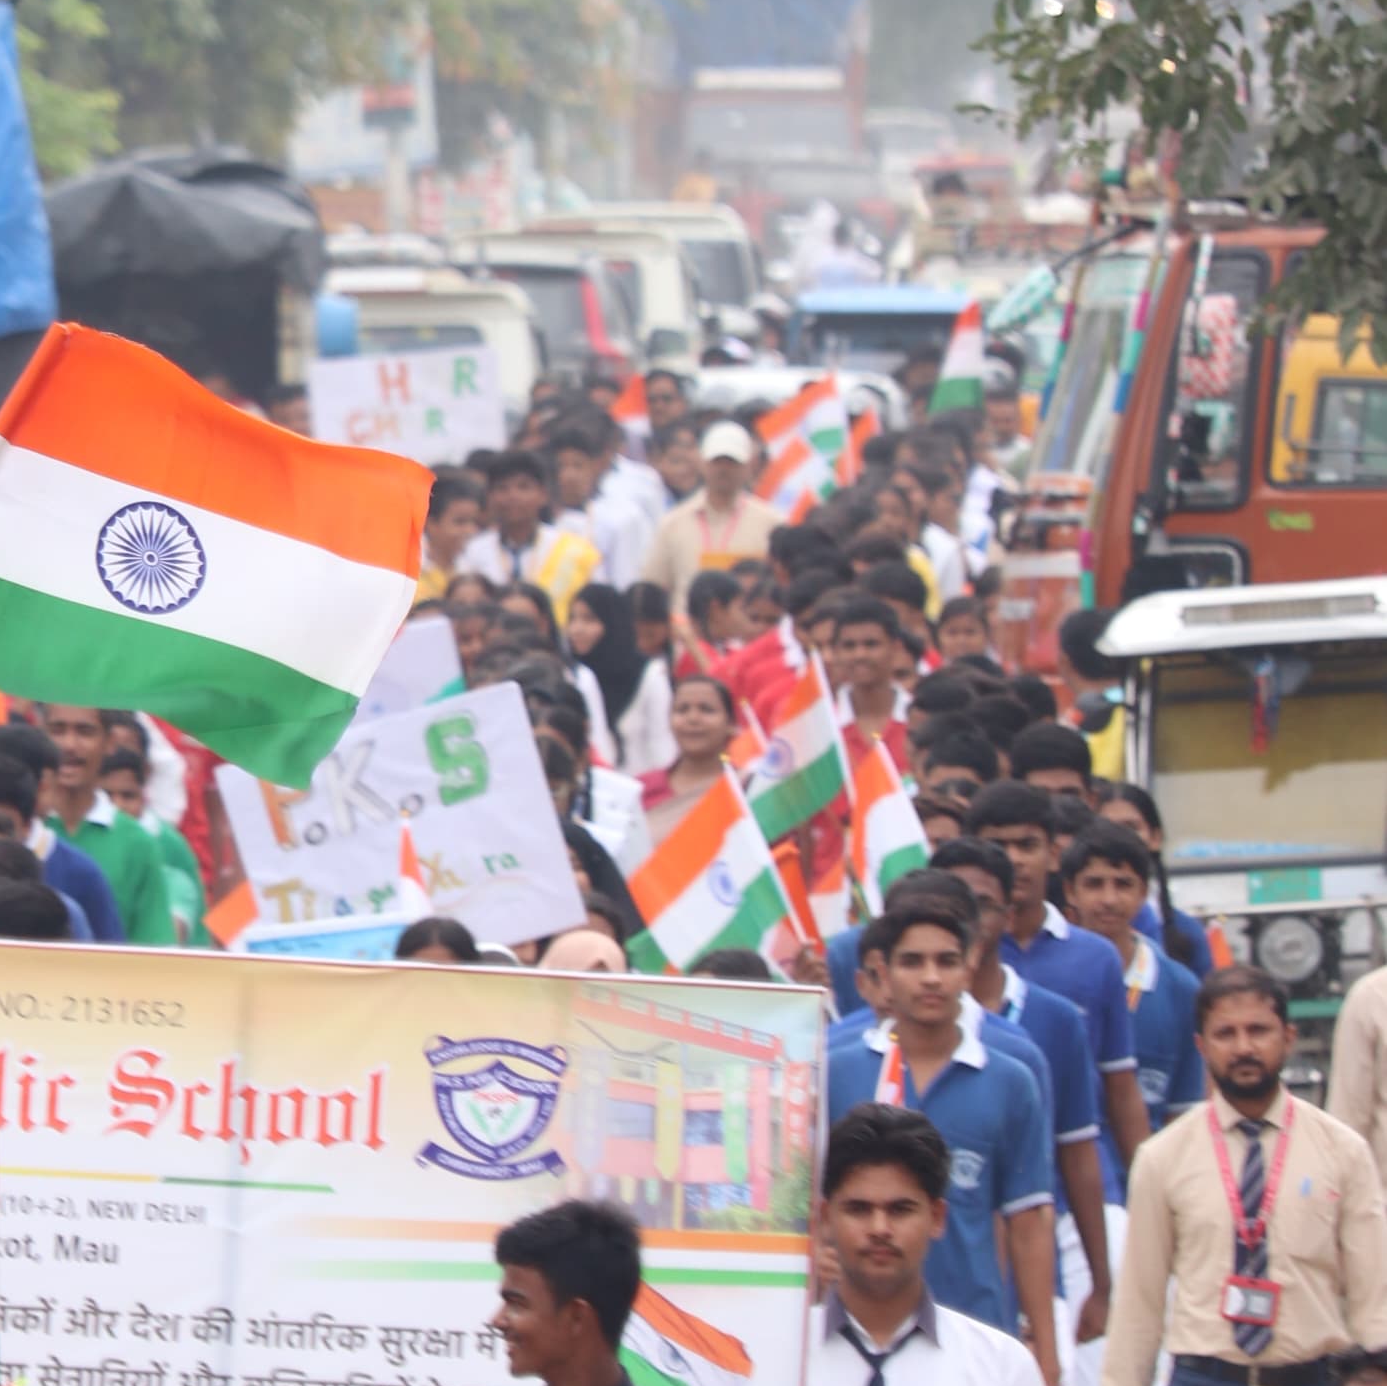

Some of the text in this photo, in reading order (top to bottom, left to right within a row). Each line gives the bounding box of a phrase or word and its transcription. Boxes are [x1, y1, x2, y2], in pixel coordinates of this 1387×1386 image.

[61, 994, 188, 1030] 2131652
[103, 1049, 386, 1166] School
[87, 1198, 137, 1222] NEW
[144, 1201, 209, 1225] DELHI
[53, 1232, 121, 1264] Mau
[63, 1296, 120, 1340] और
[127, 1301, 183, 1344] देश
[190, 1306, 236, 1346] की
[245, 1310, 370, 1352] आंतरिक
[377, 1325, 468, 1366] सुरक्षा
